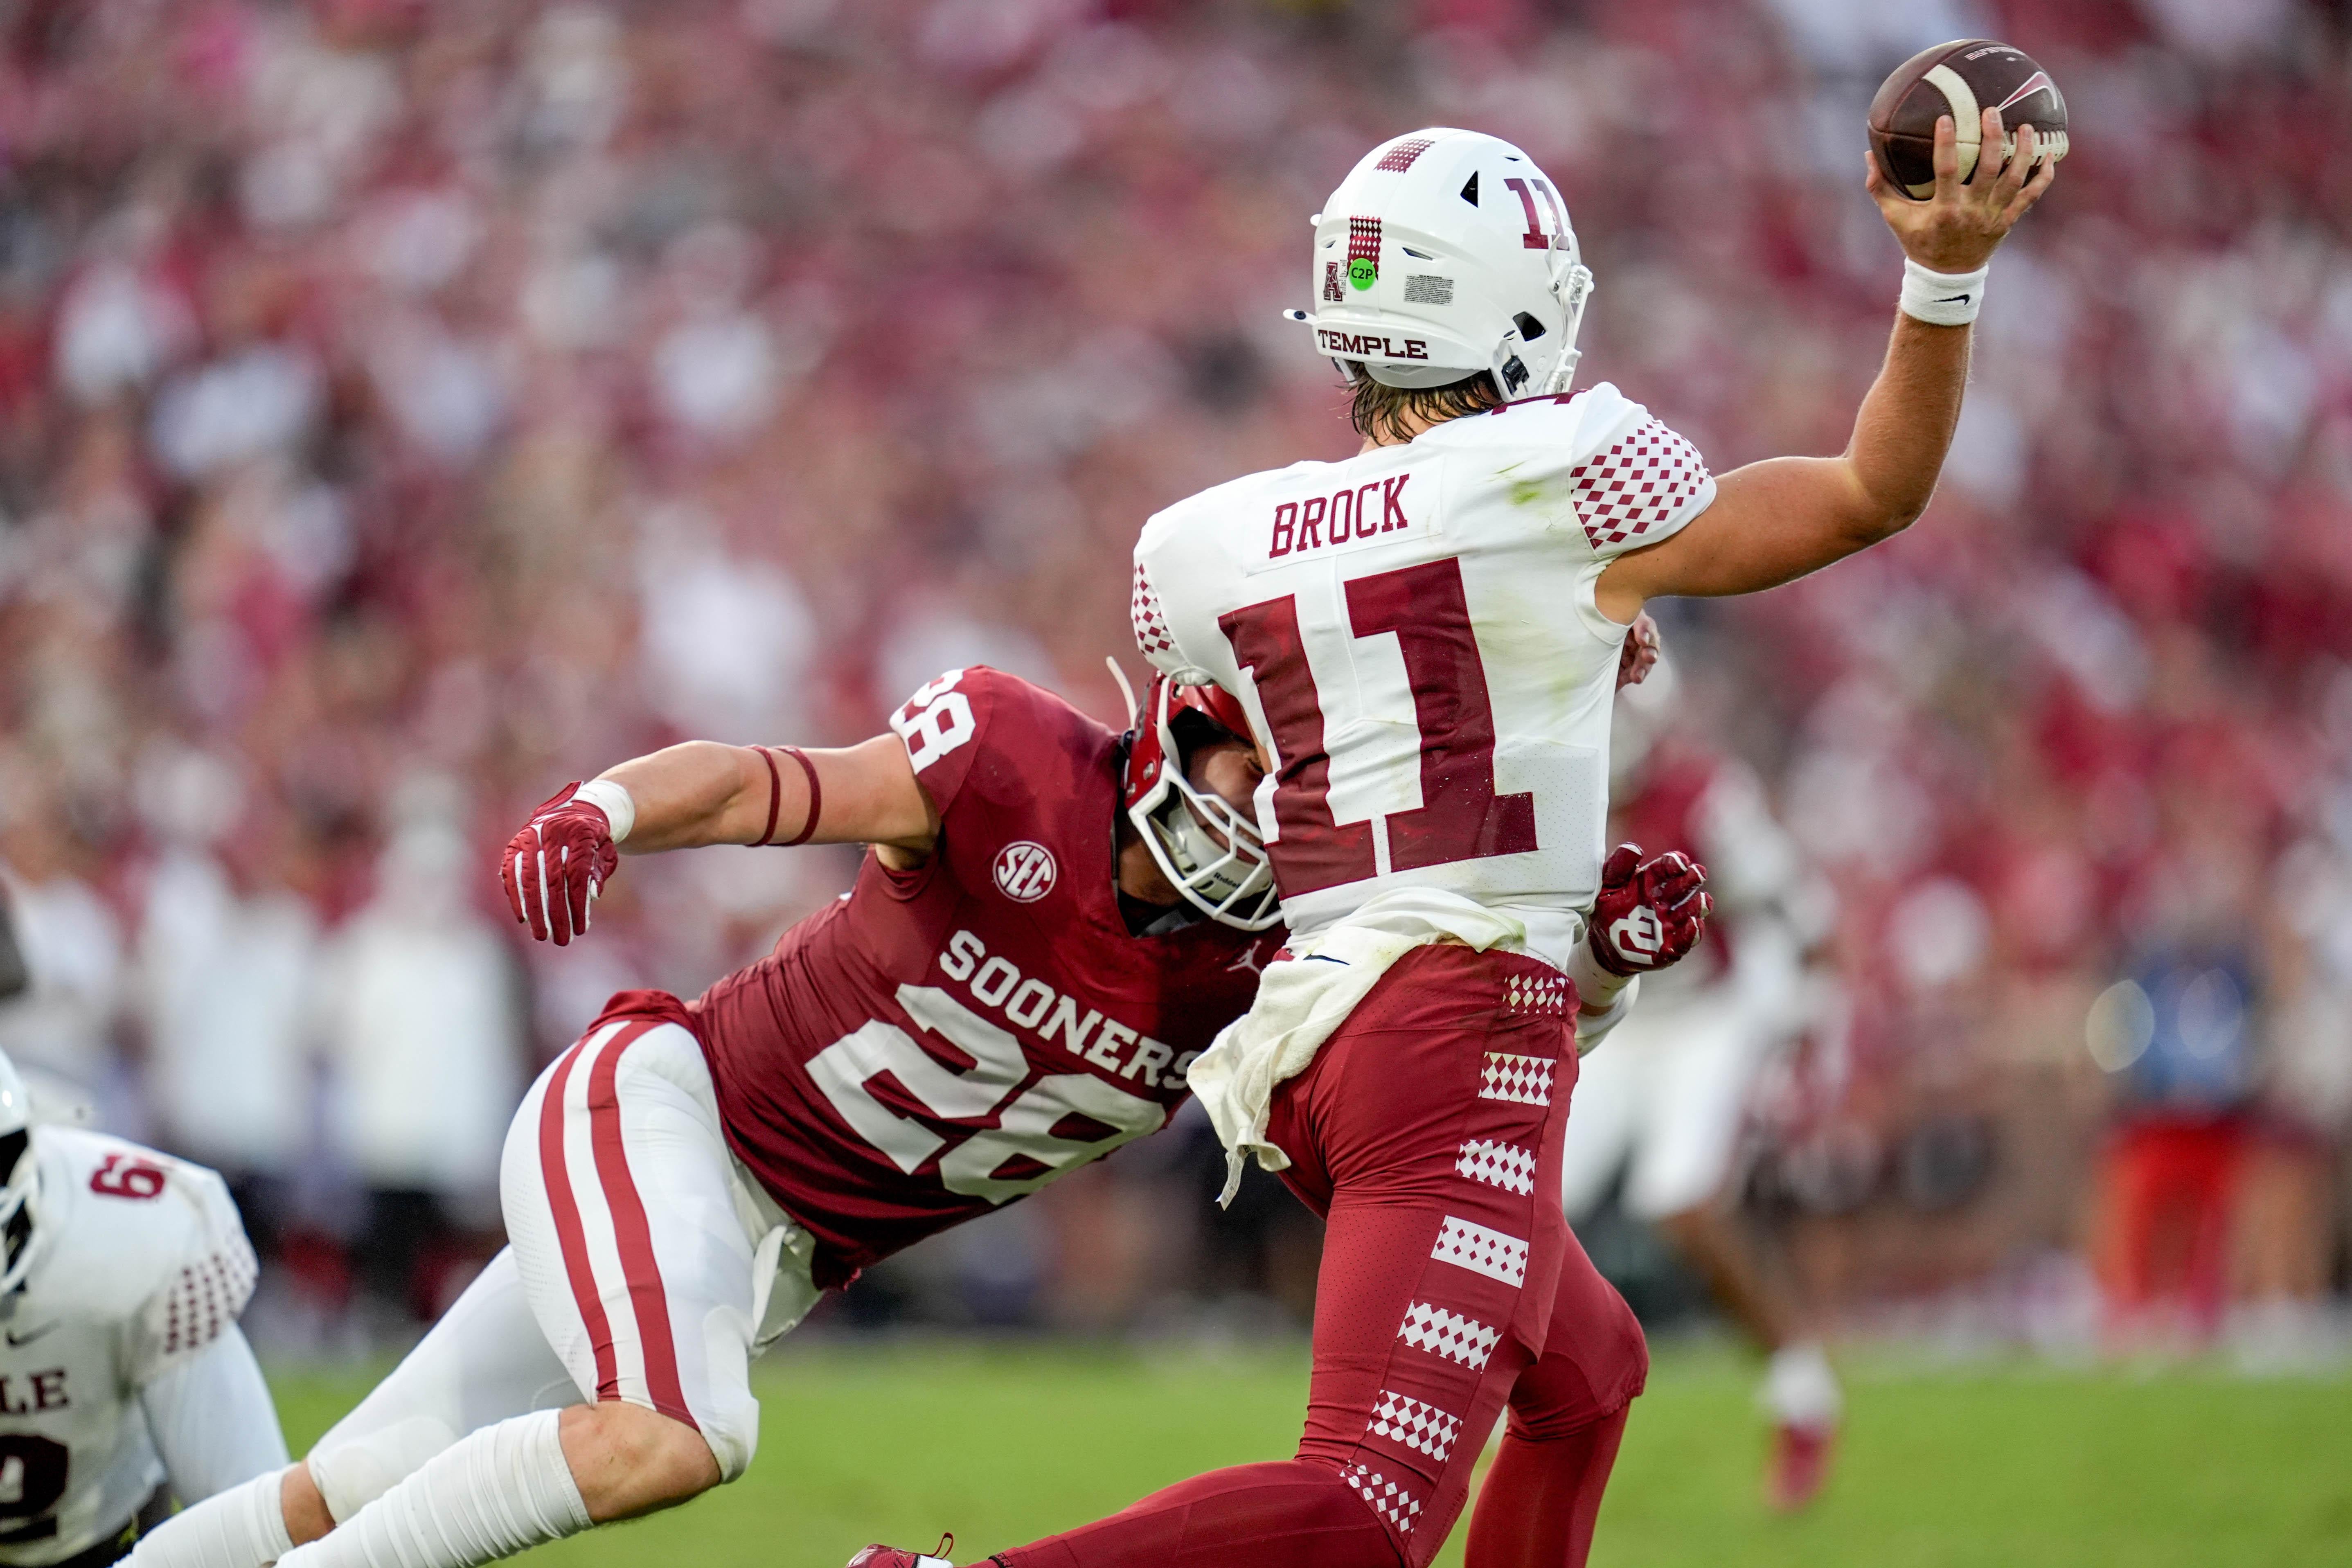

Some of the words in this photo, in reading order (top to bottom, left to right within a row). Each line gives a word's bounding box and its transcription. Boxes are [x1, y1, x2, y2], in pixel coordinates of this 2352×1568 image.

[1504, 178, 1570, 251] 11
[1351, 267, 1373, 279] C2P
[1318, 329, 1428, 359] TEMPLE
[1269, 473, 1410, 559] BROCK
[889, 669, 976, 775] 28
[1218, 556, 1539, 900] 11
[997, 845, 1052, 898] SEC
[1213, 872, 1241, 888] Riddel
[939, 930, 1203, 1089] SOONERS
[804, 983, 1166, 1205] 28
[89, 1153, 174, 1199] 6
